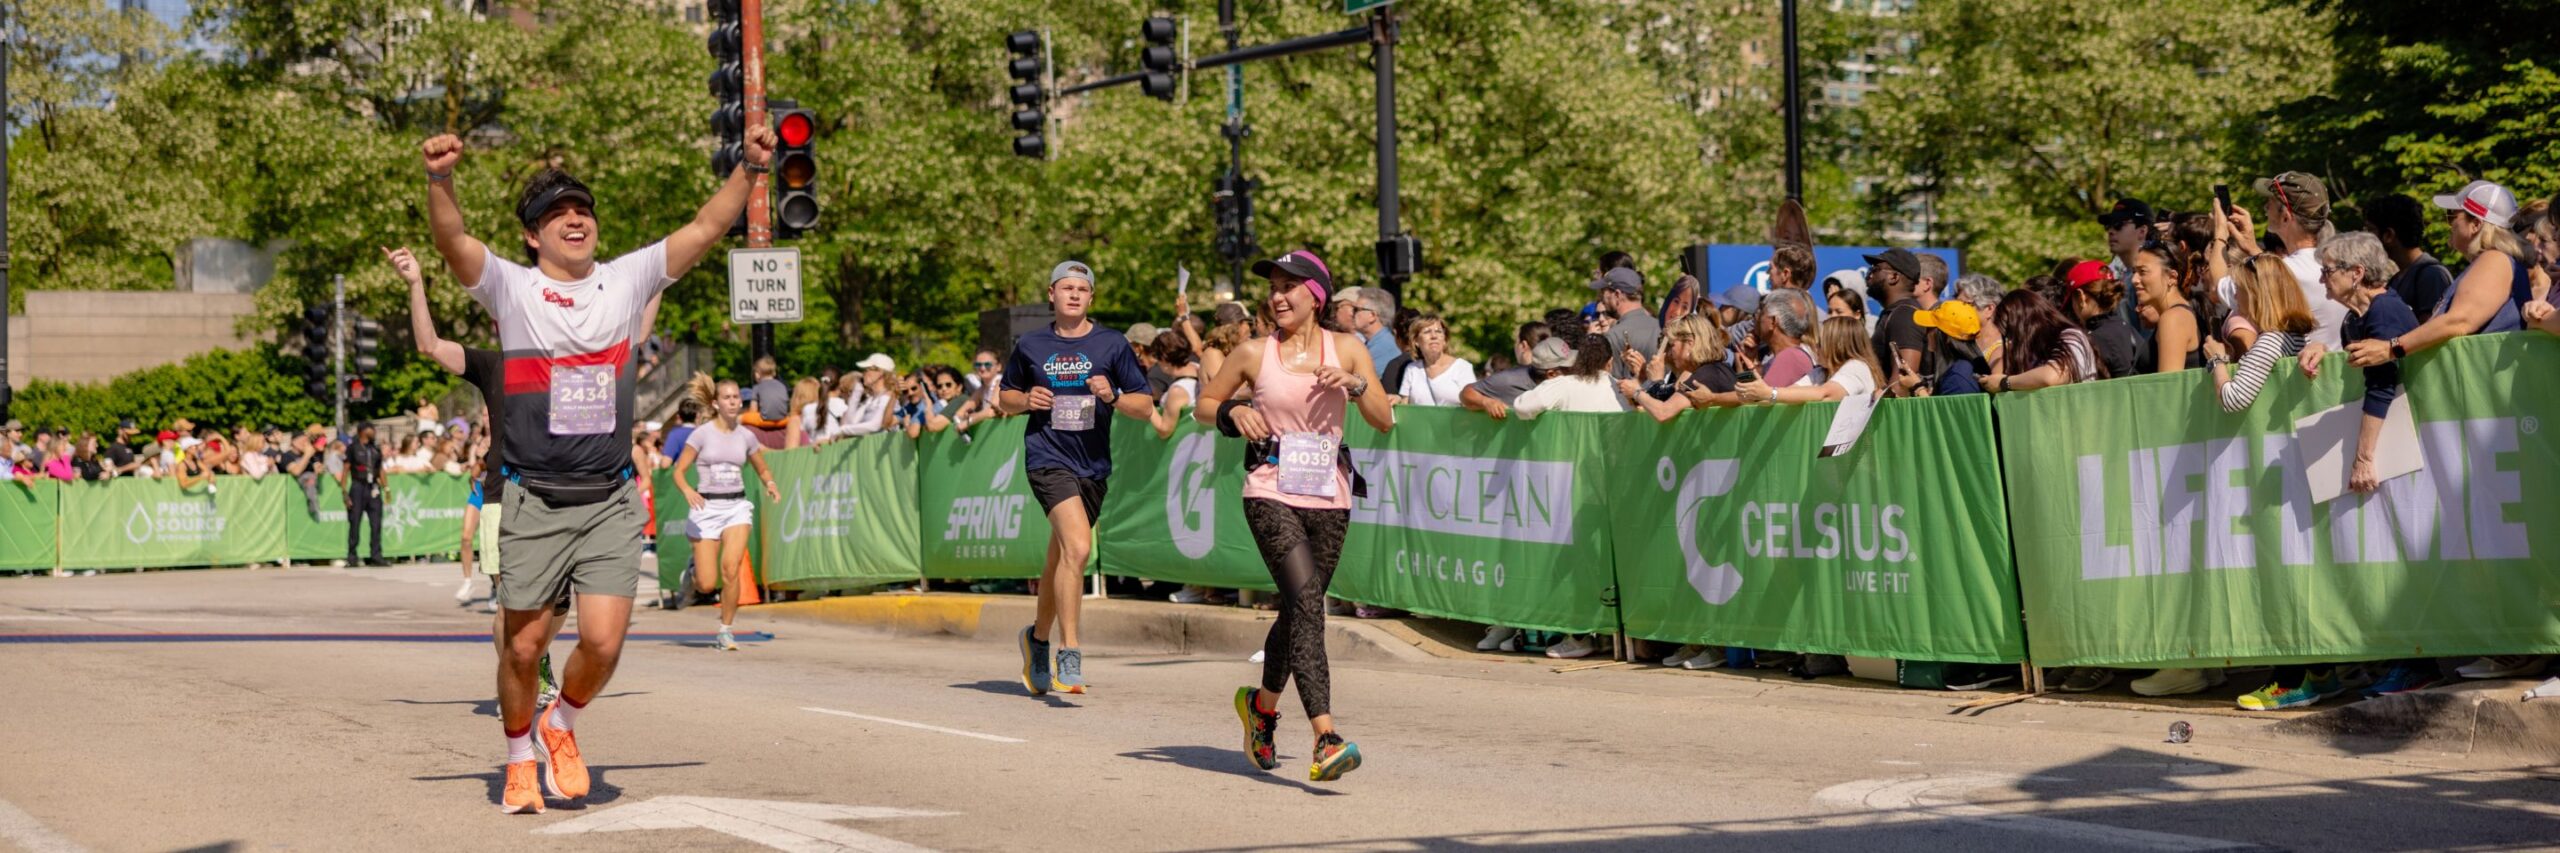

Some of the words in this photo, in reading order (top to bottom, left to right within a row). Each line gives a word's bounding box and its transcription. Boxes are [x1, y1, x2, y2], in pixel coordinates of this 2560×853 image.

[753, 260, 777, 272] NO
[747, 279, 786, 292] TURN
[739, 300, 758, 311] ON
[768, 298, 795, 311] RED
[1044, 362, 1092, 371] CHICAGO
[560, 387, 608, 402] 2434
[1286, 451, 1330, 466] 4039
[1358, 461, 1417, 516] EAT
[1426, 467, 1551, 528] CLEAN
[157, 502, 217, 516] PROUD
[156, 517, 225, 531] SOURCE
[944, 495, 1024, 540] SPRING
[1741, 501, 1909, 562] CELSIUS
[956, 544, 1007, 558] ENERGY
[1395, 550, 1505, 588] CHICAGO
[1846, 570, 1877, 592] LIVE
[1884, 571, 1910, 594] FIT
